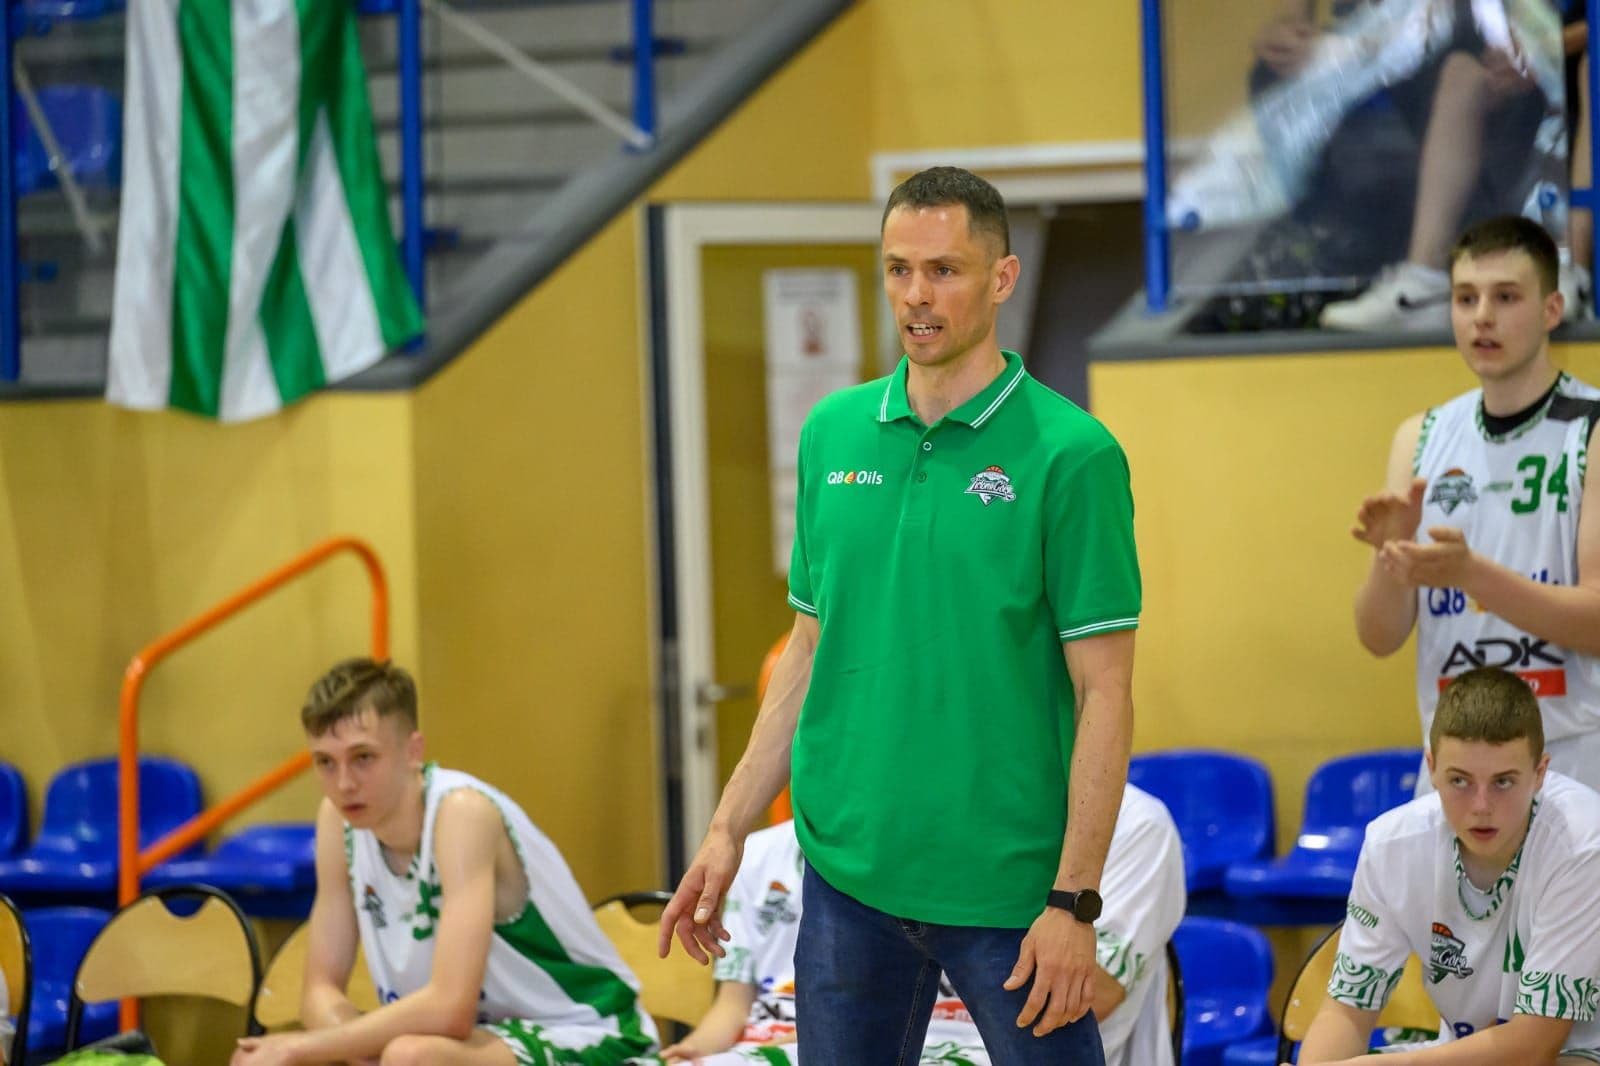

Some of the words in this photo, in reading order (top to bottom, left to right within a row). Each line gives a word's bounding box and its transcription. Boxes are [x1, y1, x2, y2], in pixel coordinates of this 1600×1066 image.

[856, 470, 884, 485] Oils
[1511, 453, 1568, 514] 34
[1441, 637, 1564, 675] ADK
